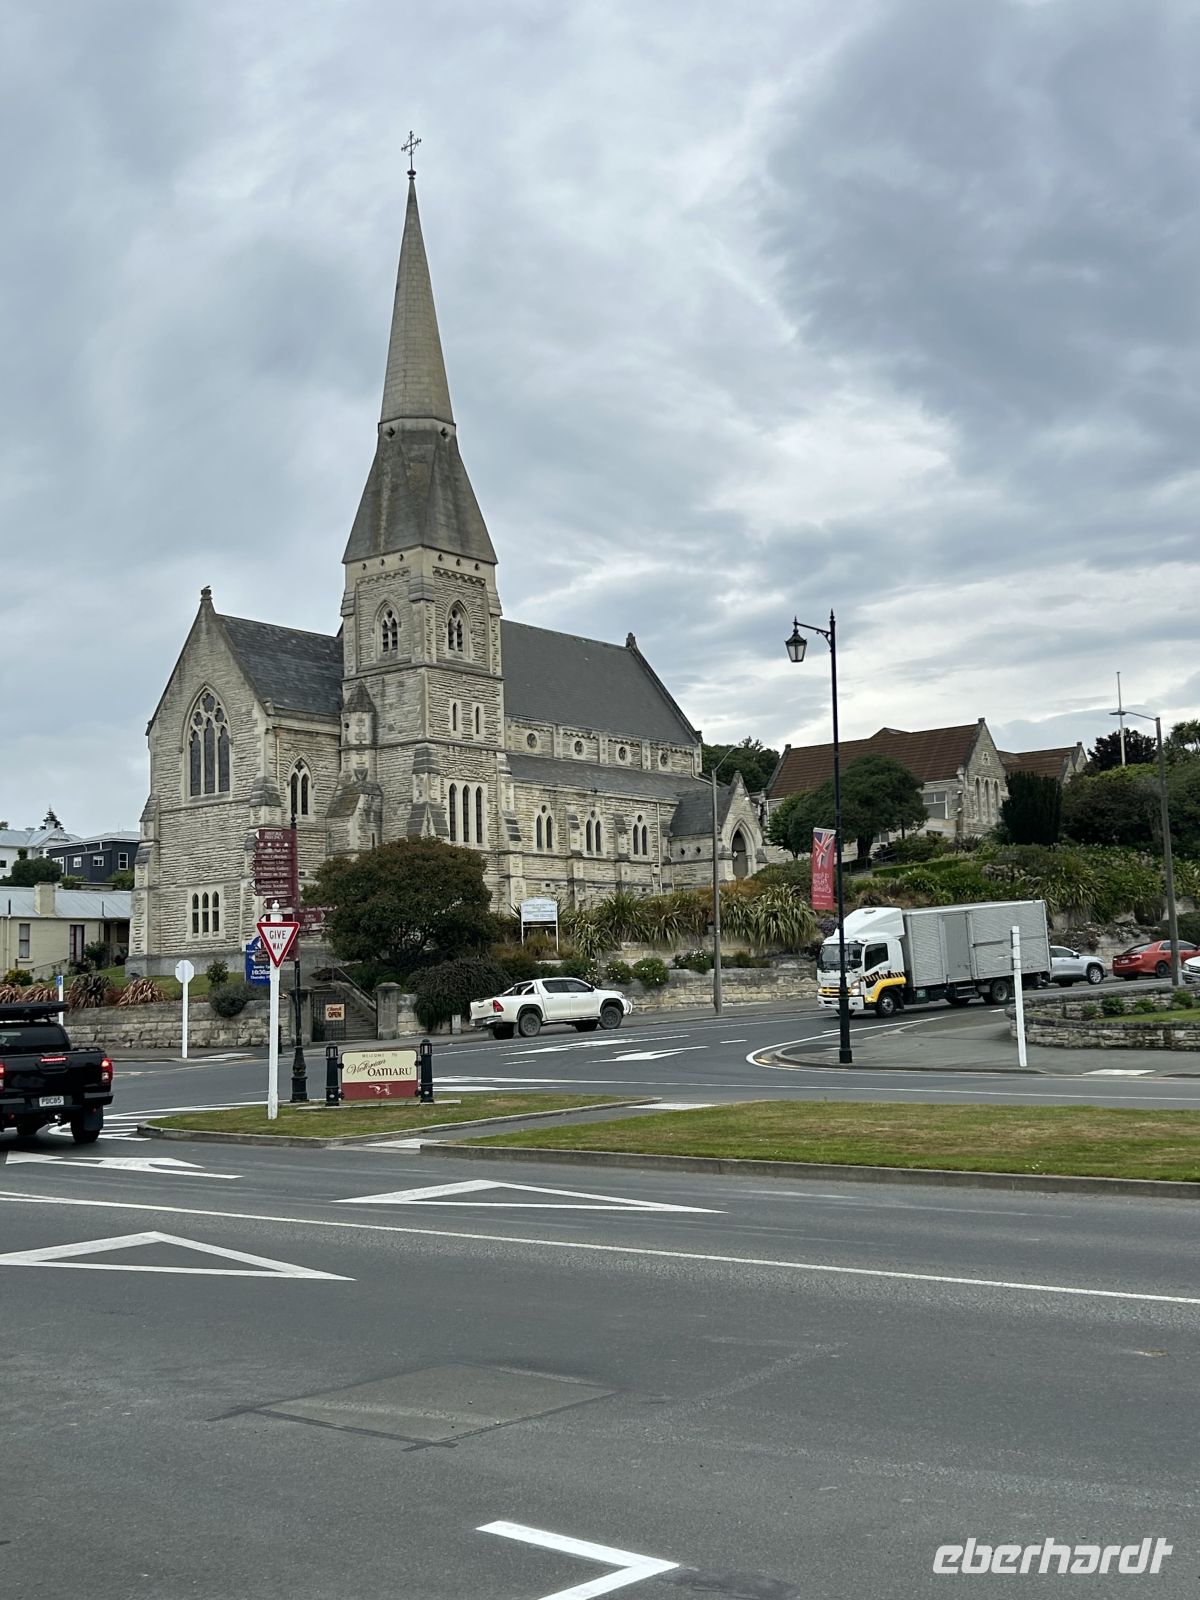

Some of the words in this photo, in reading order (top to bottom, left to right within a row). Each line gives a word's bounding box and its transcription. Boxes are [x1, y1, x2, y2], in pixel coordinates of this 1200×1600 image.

[269, 930, 287, 940] GIVE
[272, 942, 283, 950] WAY
[346, 1059, 386, 1075] Victorian
[367, 1067, 412, 1077] OAMARU
